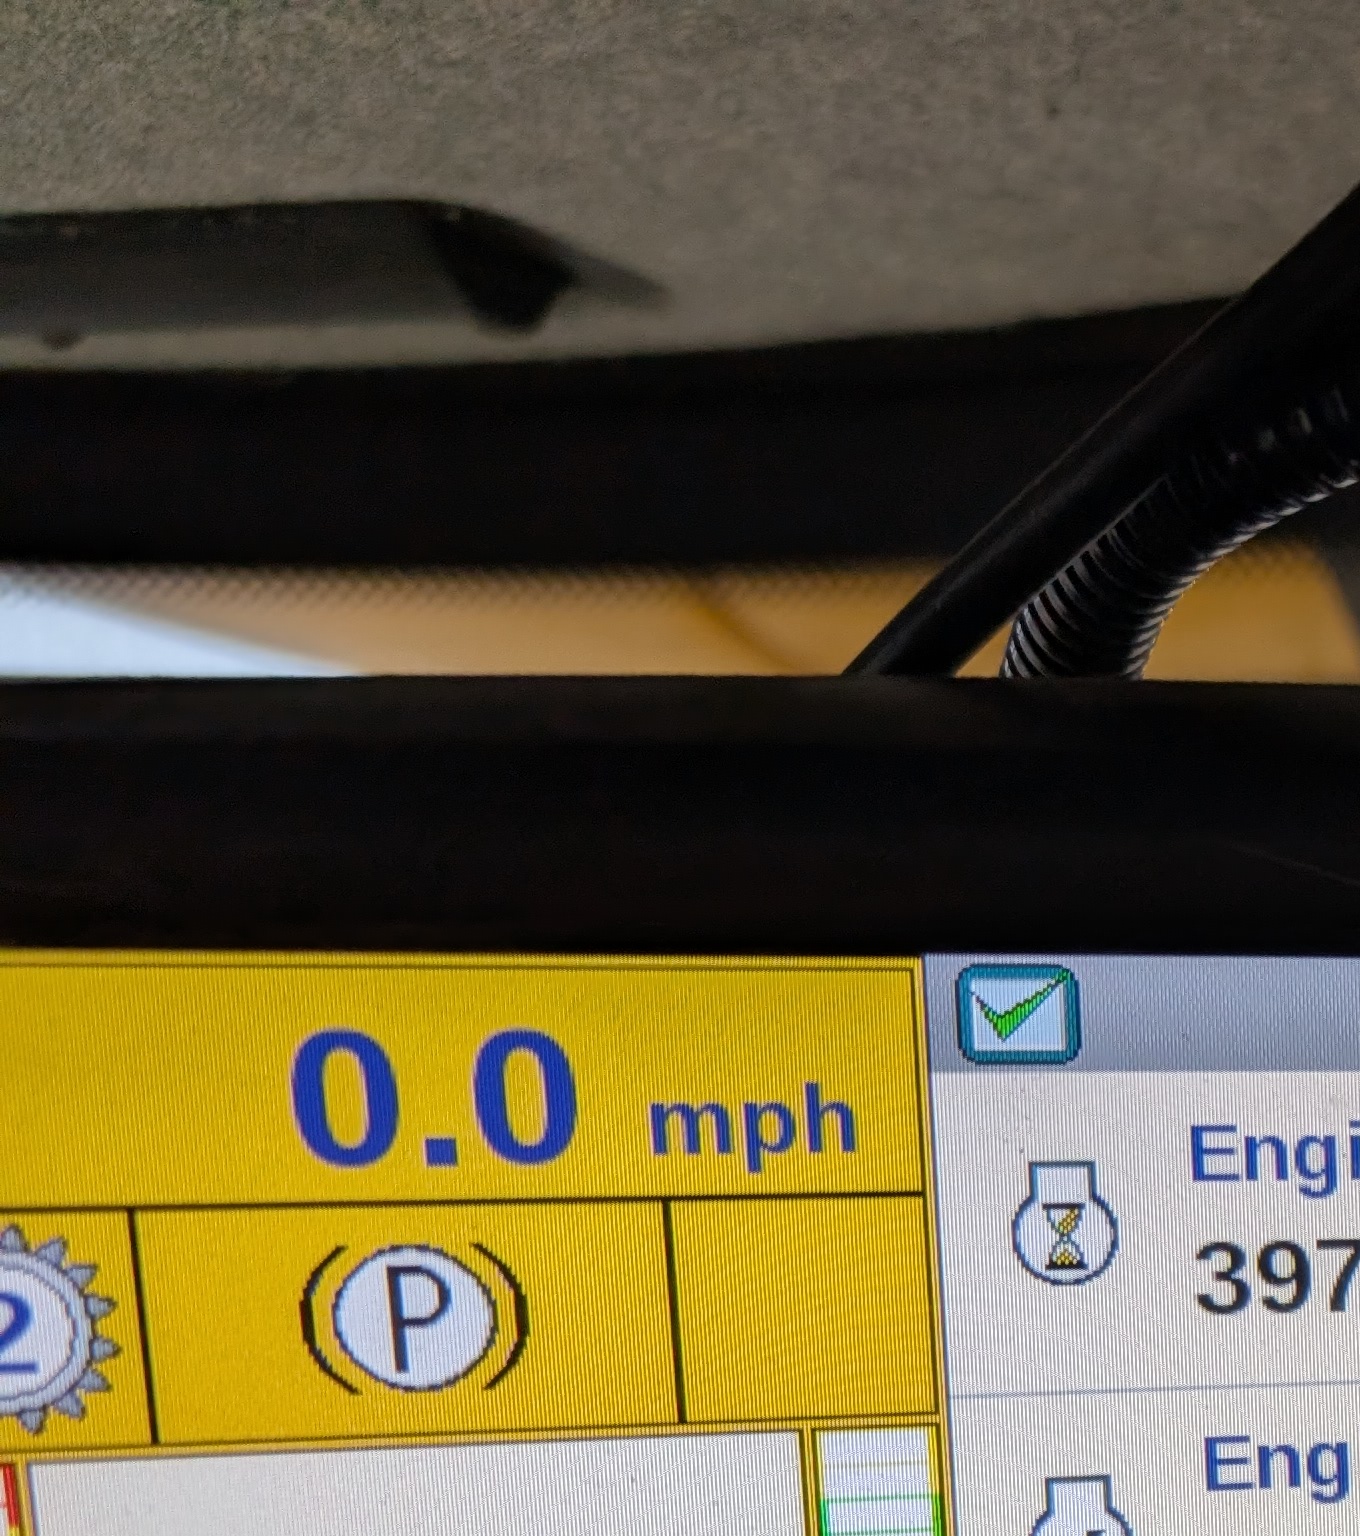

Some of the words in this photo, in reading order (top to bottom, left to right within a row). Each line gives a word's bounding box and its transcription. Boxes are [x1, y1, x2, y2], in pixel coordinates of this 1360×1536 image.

[290, 1027, 578, 1168] 0.0
[650, 1081, 857, 1173] mph
[386, 1265, 450, 1372] P
